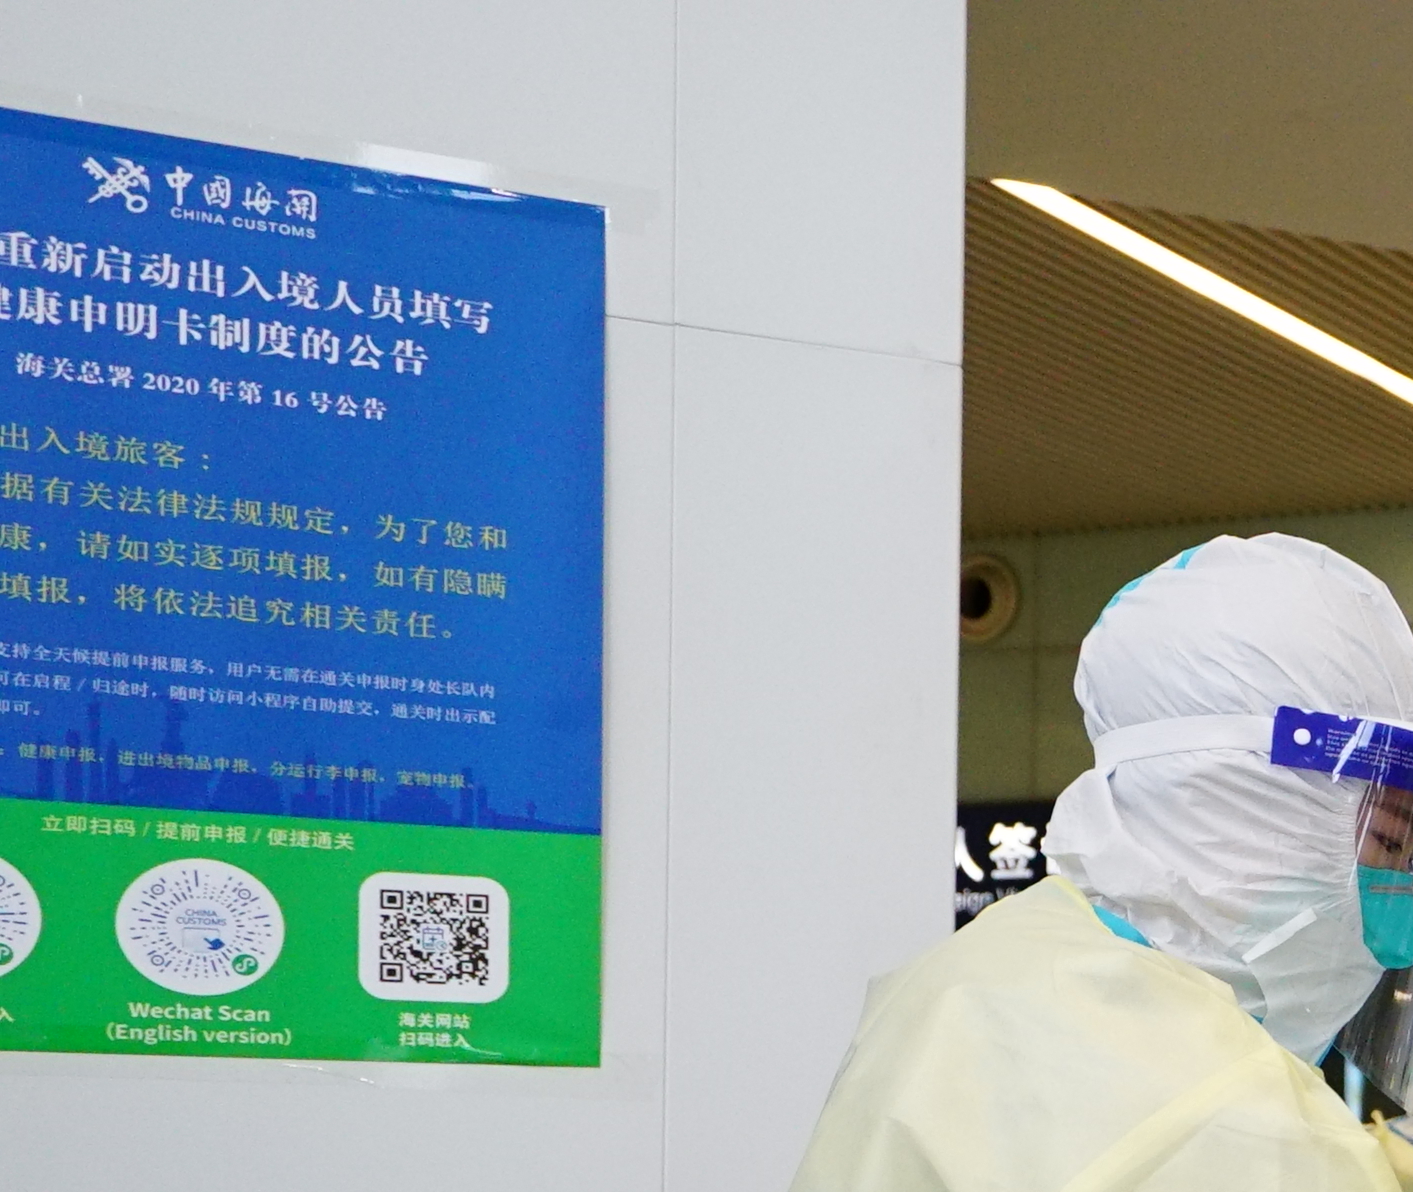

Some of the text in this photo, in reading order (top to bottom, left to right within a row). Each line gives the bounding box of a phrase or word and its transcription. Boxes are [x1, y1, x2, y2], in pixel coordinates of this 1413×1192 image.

[170, 206, 317, 240] CHINA CUSTOMS
[15, 351, 388, 421] 海关总署 2020 年第 16 号公告
[41, 814, 137, 838] 立即扫码
[155, 820, 248, 844] 提前申报
[266, 828, 355, 851] 便捷通关
[176, 916, 227, 927] CUSTOMS
[183, 908, 218, 918] CHINA
[127, 1002, 271, 1022] Wechat Scan
[106, 1022, 292, 1046] (English version)
